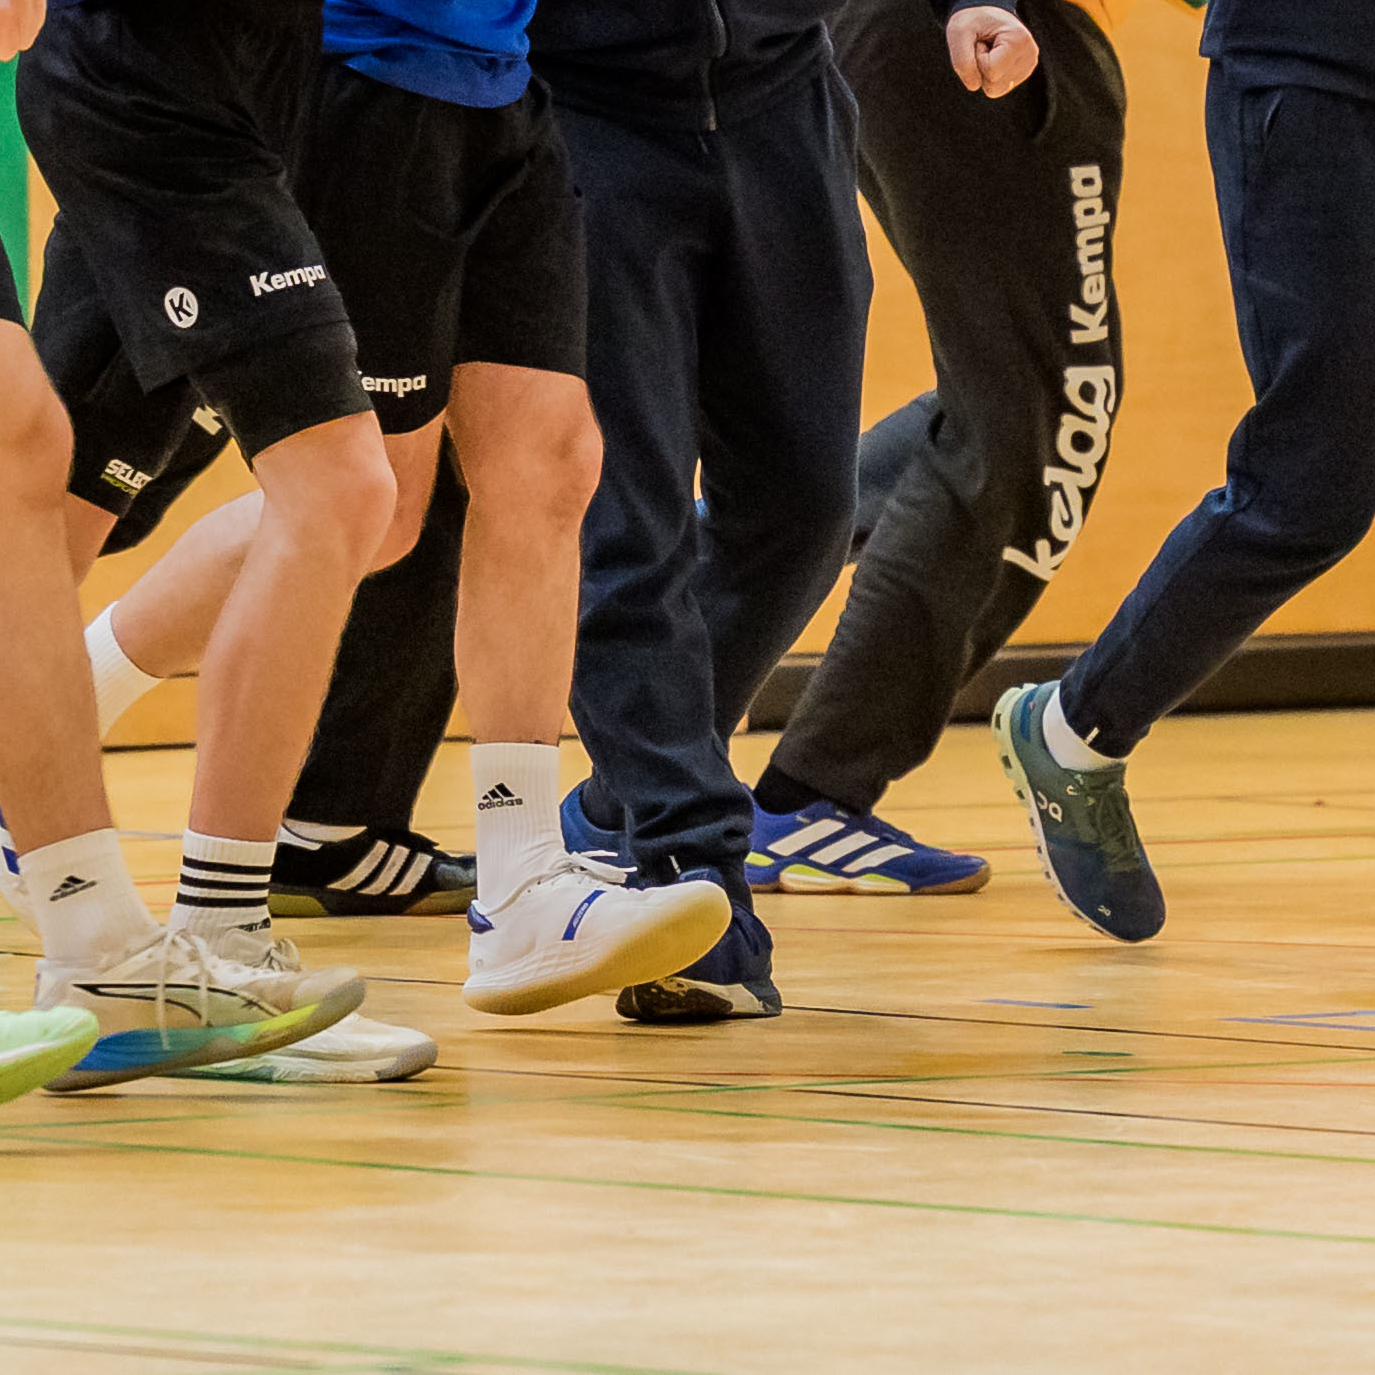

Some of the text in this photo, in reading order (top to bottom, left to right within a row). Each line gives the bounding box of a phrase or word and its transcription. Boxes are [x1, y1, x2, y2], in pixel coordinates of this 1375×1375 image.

[1069, 164, 1111, 344] Kempa
[250, 264, 327, 297] Kempa
[361, 374, 427, 398] empa
[104, 459, 154, 490] SELEC
[1002, 364, 1116, 582] kelag
[477, 797, 523, 811] adidas
